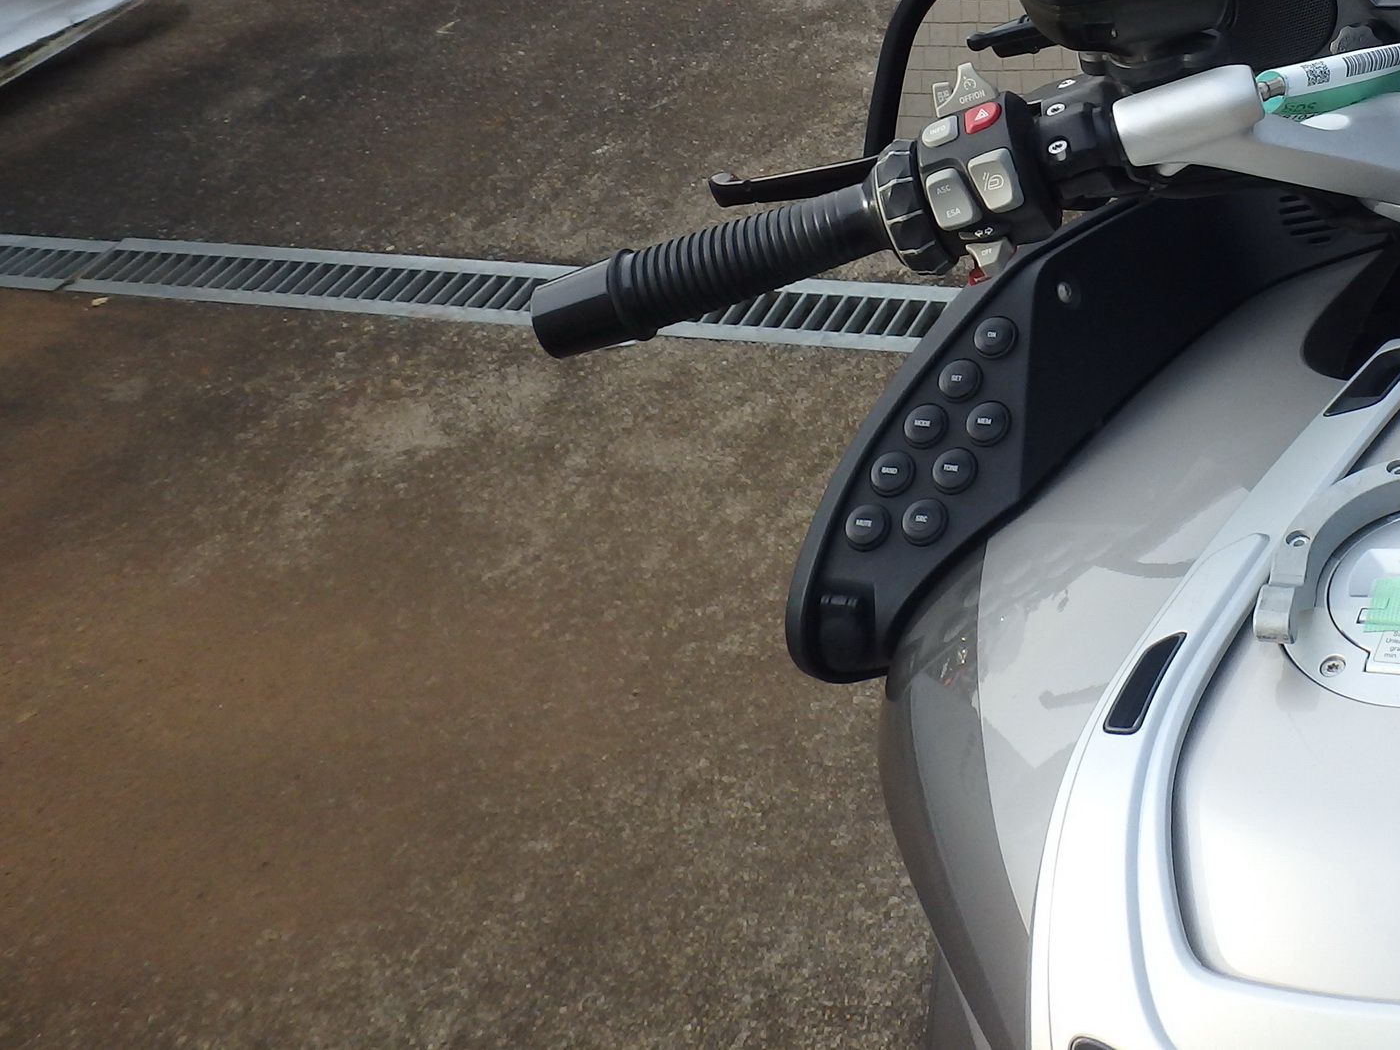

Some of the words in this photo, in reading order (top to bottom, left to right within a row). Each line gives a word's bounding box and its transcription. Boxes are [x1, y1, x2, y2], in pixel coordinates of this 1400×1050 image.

[958, 89, 986, 105] OFF/ON
[929, 125, 947, 136] INFO
[936, 184, 952, 195] ASC
[946, 208, 962, 219] ESA
[856, 519, 873, 527] MUTE
